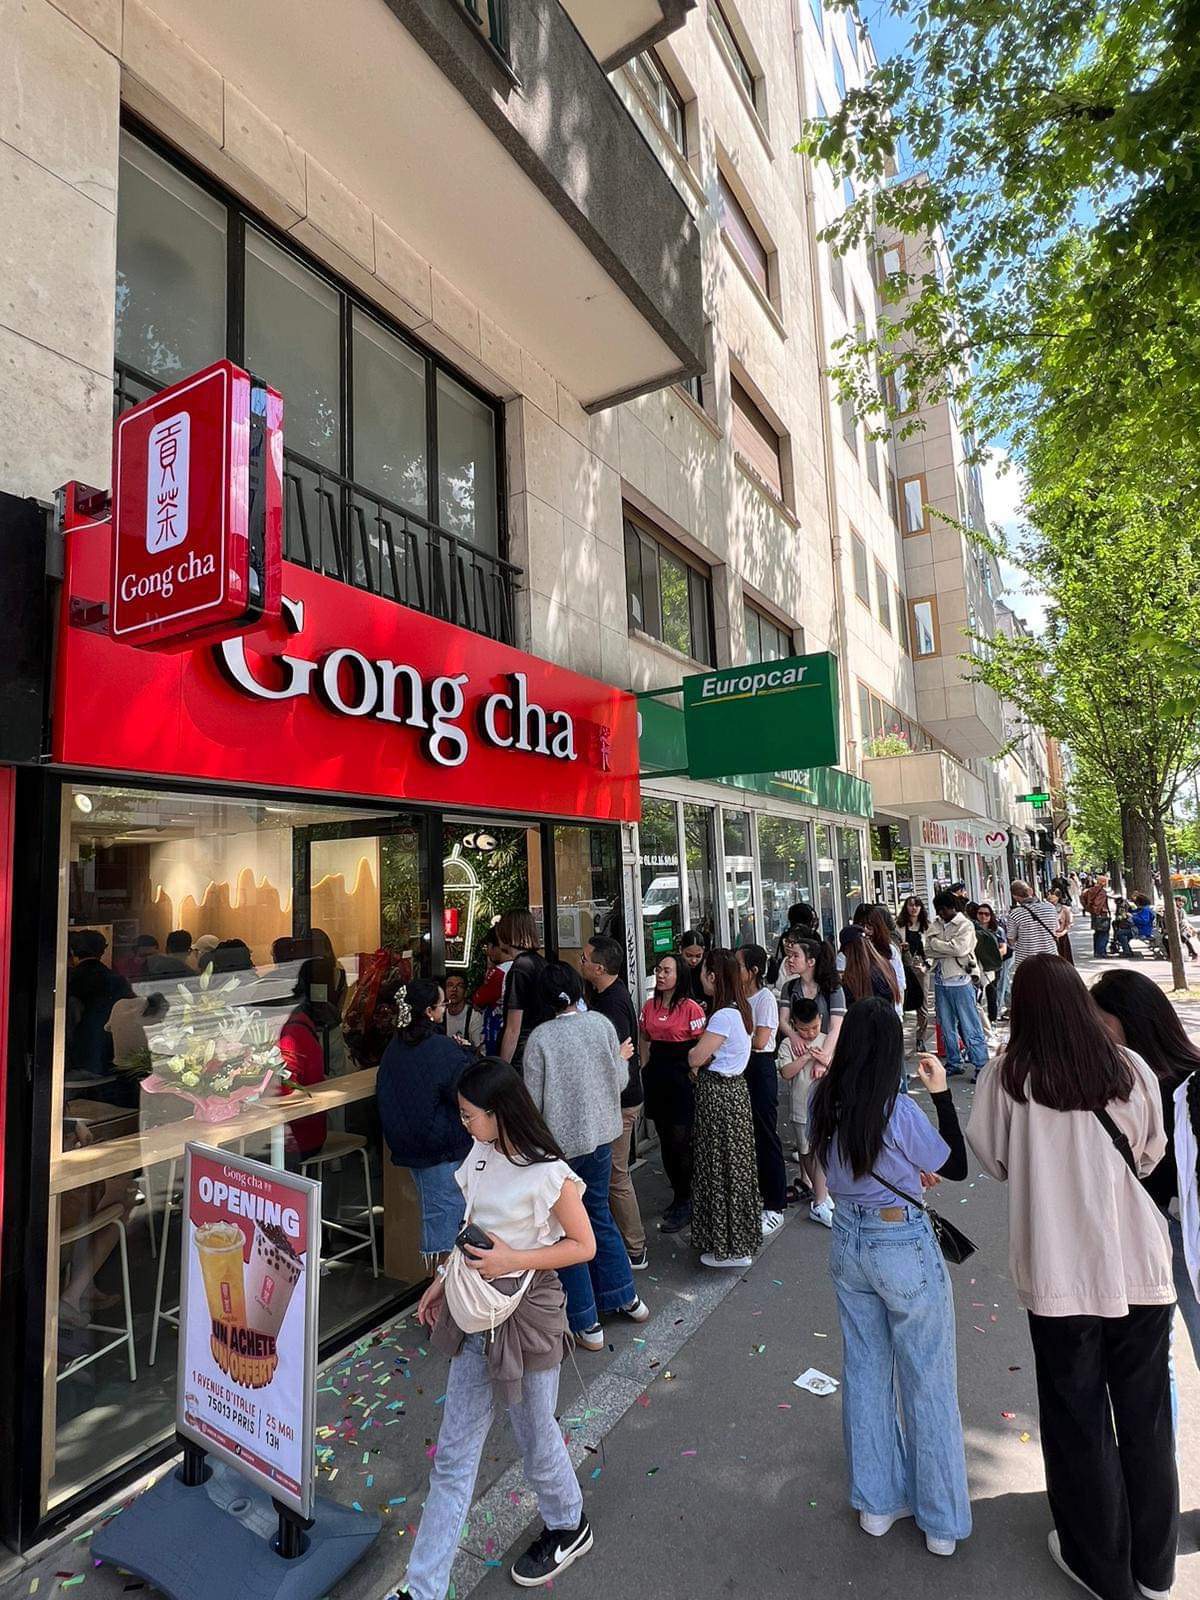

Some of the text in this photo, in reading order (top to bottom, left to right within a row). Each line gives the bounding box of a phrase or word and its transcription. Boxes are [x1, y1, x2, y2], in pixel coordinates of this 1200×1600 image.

[155, 420, 182, 546] 貢茶
[121, 550, 215, 602] Gong cha
[221, 594, 577, 767] Gong cha
[702, 665, 808, 697] Europcar
[223, 1165, 246, 1187] Gong
[247, 1174, 263, 1190] cha
[198, 1176, 300, 1238] OPENING
[212, 1319, 228, 1345] UN
[229, 1352, 279, 1389] OFFERT
[192, 1370, 256, 1416] 1 AVENUE D'ITALIE
[207, 1395, 255, 1435] 75013 PARIS
[265, 1414, 295, 1441] 25 MAI
[265, 1430, 280, 1451] 13H
